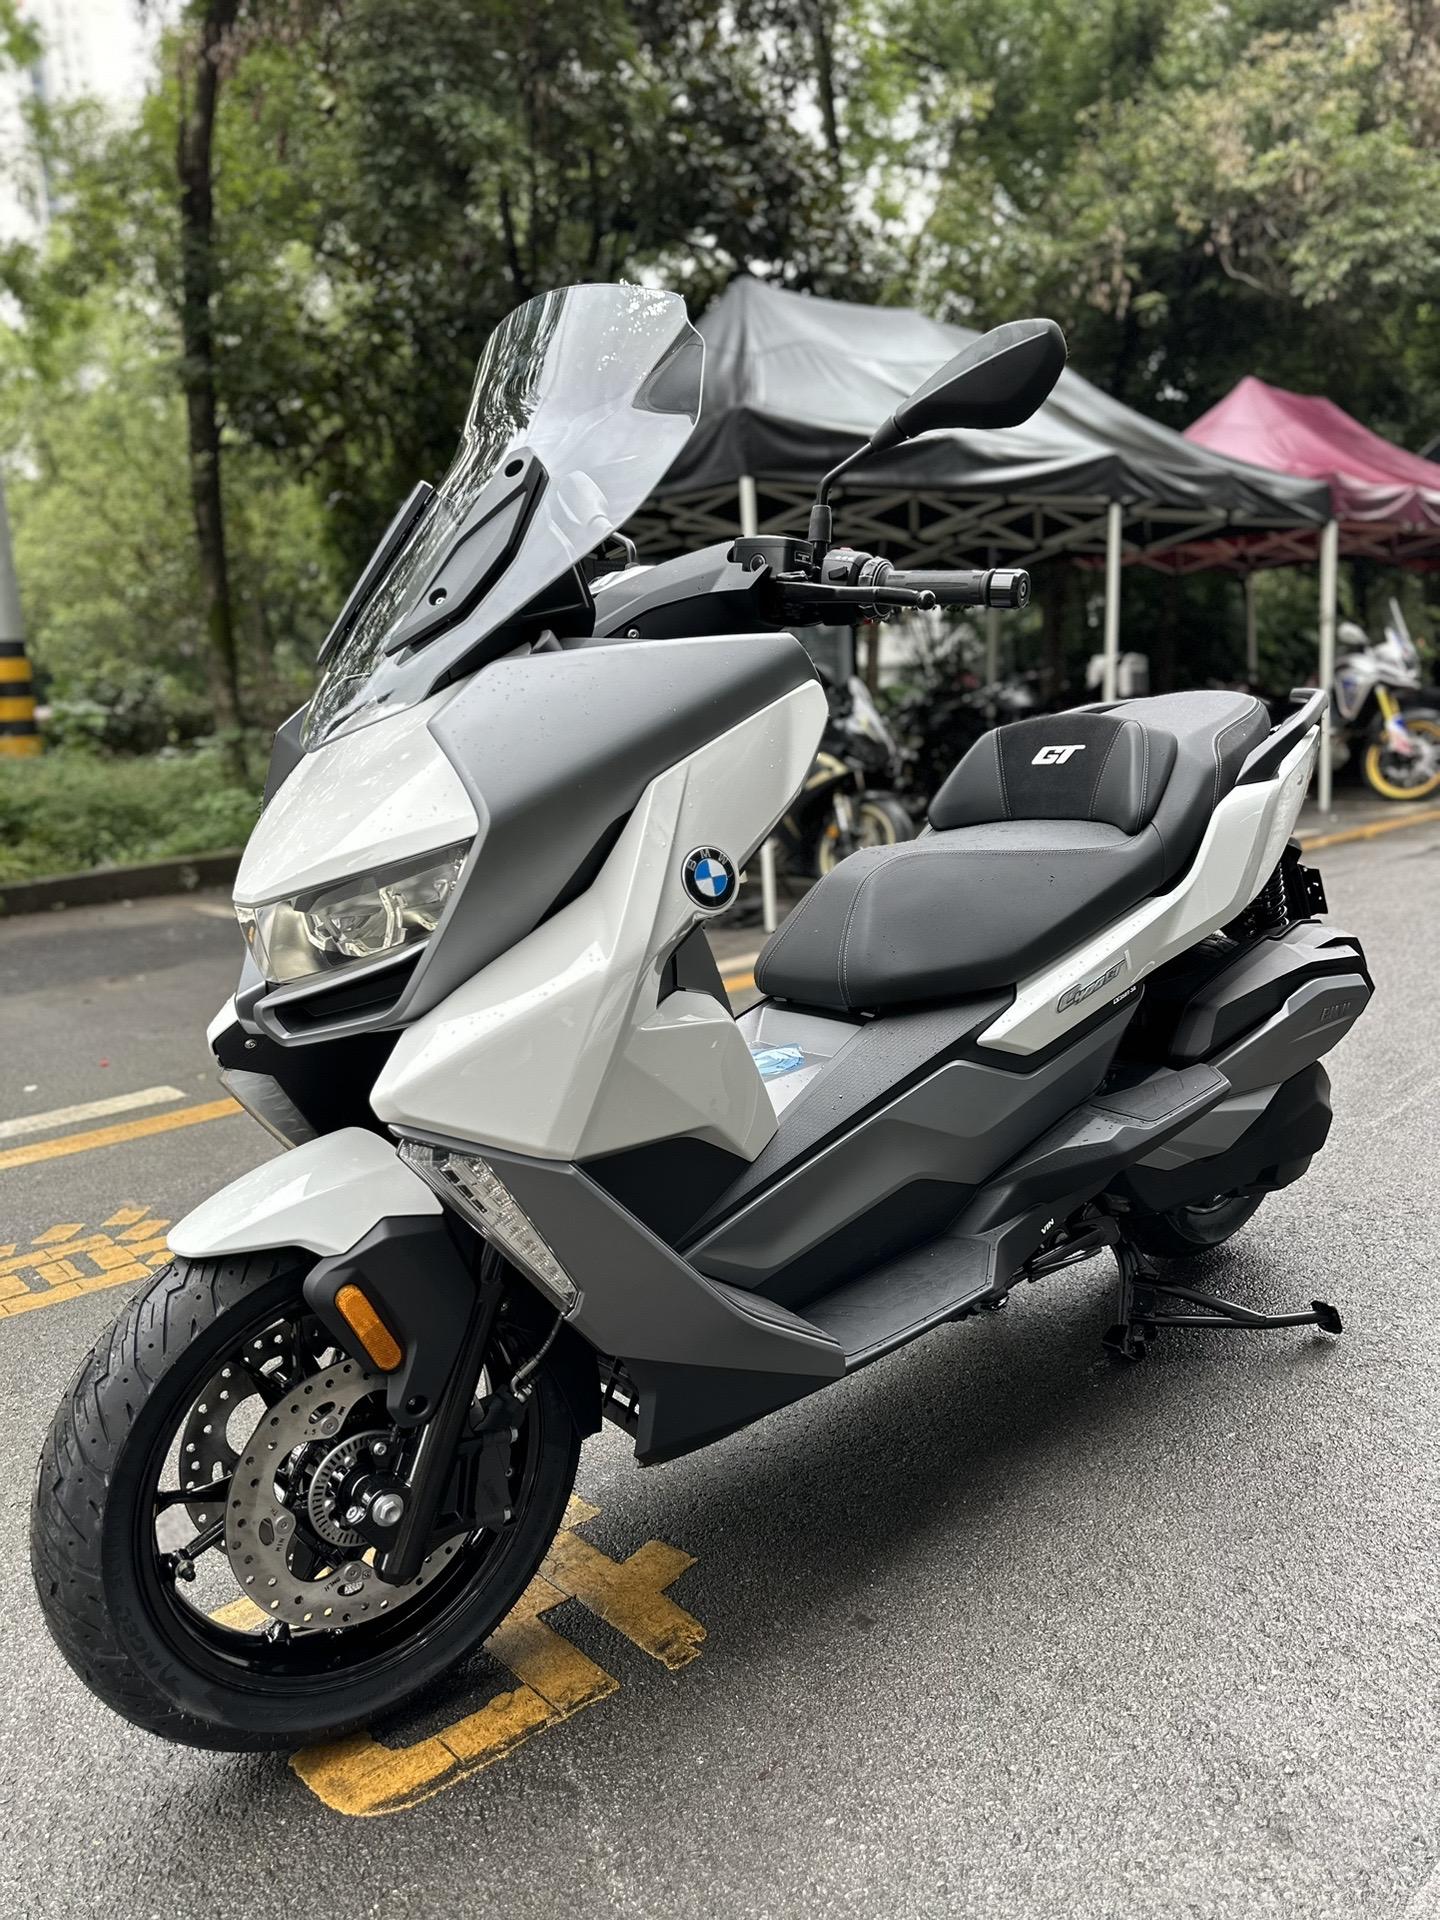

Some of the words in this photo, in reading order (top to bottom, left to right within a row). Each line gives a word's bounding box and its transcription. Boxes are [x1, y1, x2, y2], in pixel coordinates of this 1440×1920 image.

[1031, 744, 1086, 765] GT
[687, 848, 727, 871] BMW
[1040, 1218, 1055, 1234] VIN
